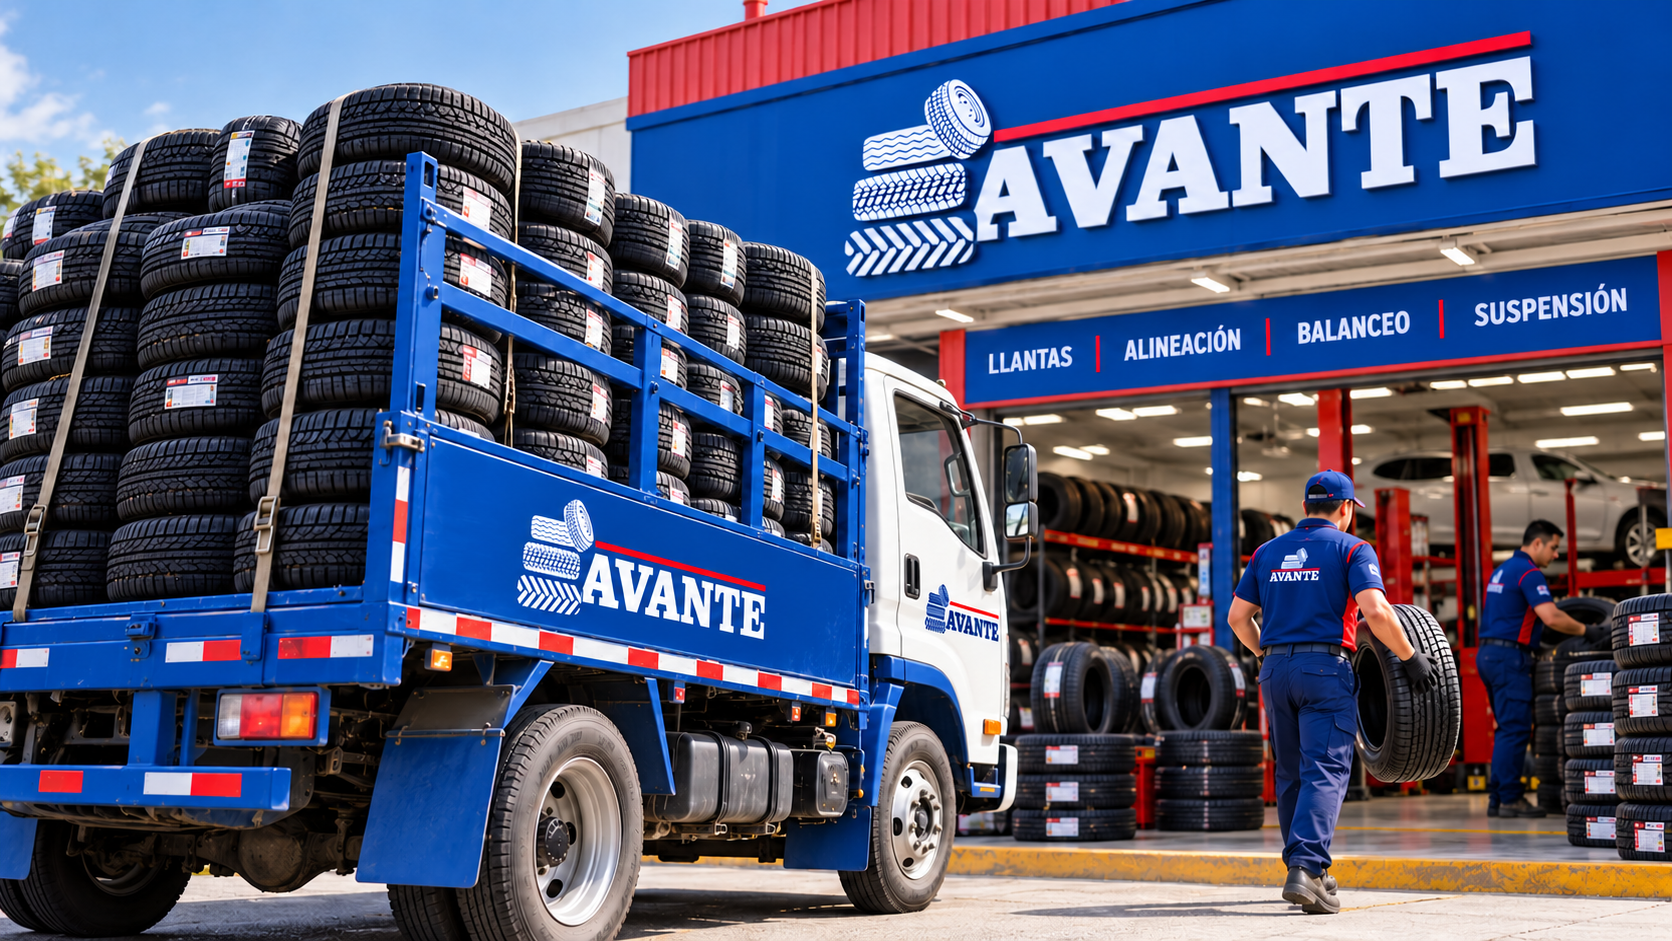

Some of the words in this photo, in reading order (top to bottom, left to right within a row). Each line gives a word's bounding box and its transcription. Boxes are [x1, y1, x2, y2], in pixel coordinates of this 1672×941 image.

[974, 56, 1537, 241] AVANTE
[988, 345, 1073, 374] LLANTAS
[1125, 325, 1241, 360] ALINEACIÓN
[1297, 310, 1411, 344] BALANCEO
[1475, 283, 1628, 326] SUSPENSIÓN
[583, 552, 765, 639] AVANTE
[1269, 570, 1320, 582] AVANTE
[946, 610, 999, 642] AVANTE
